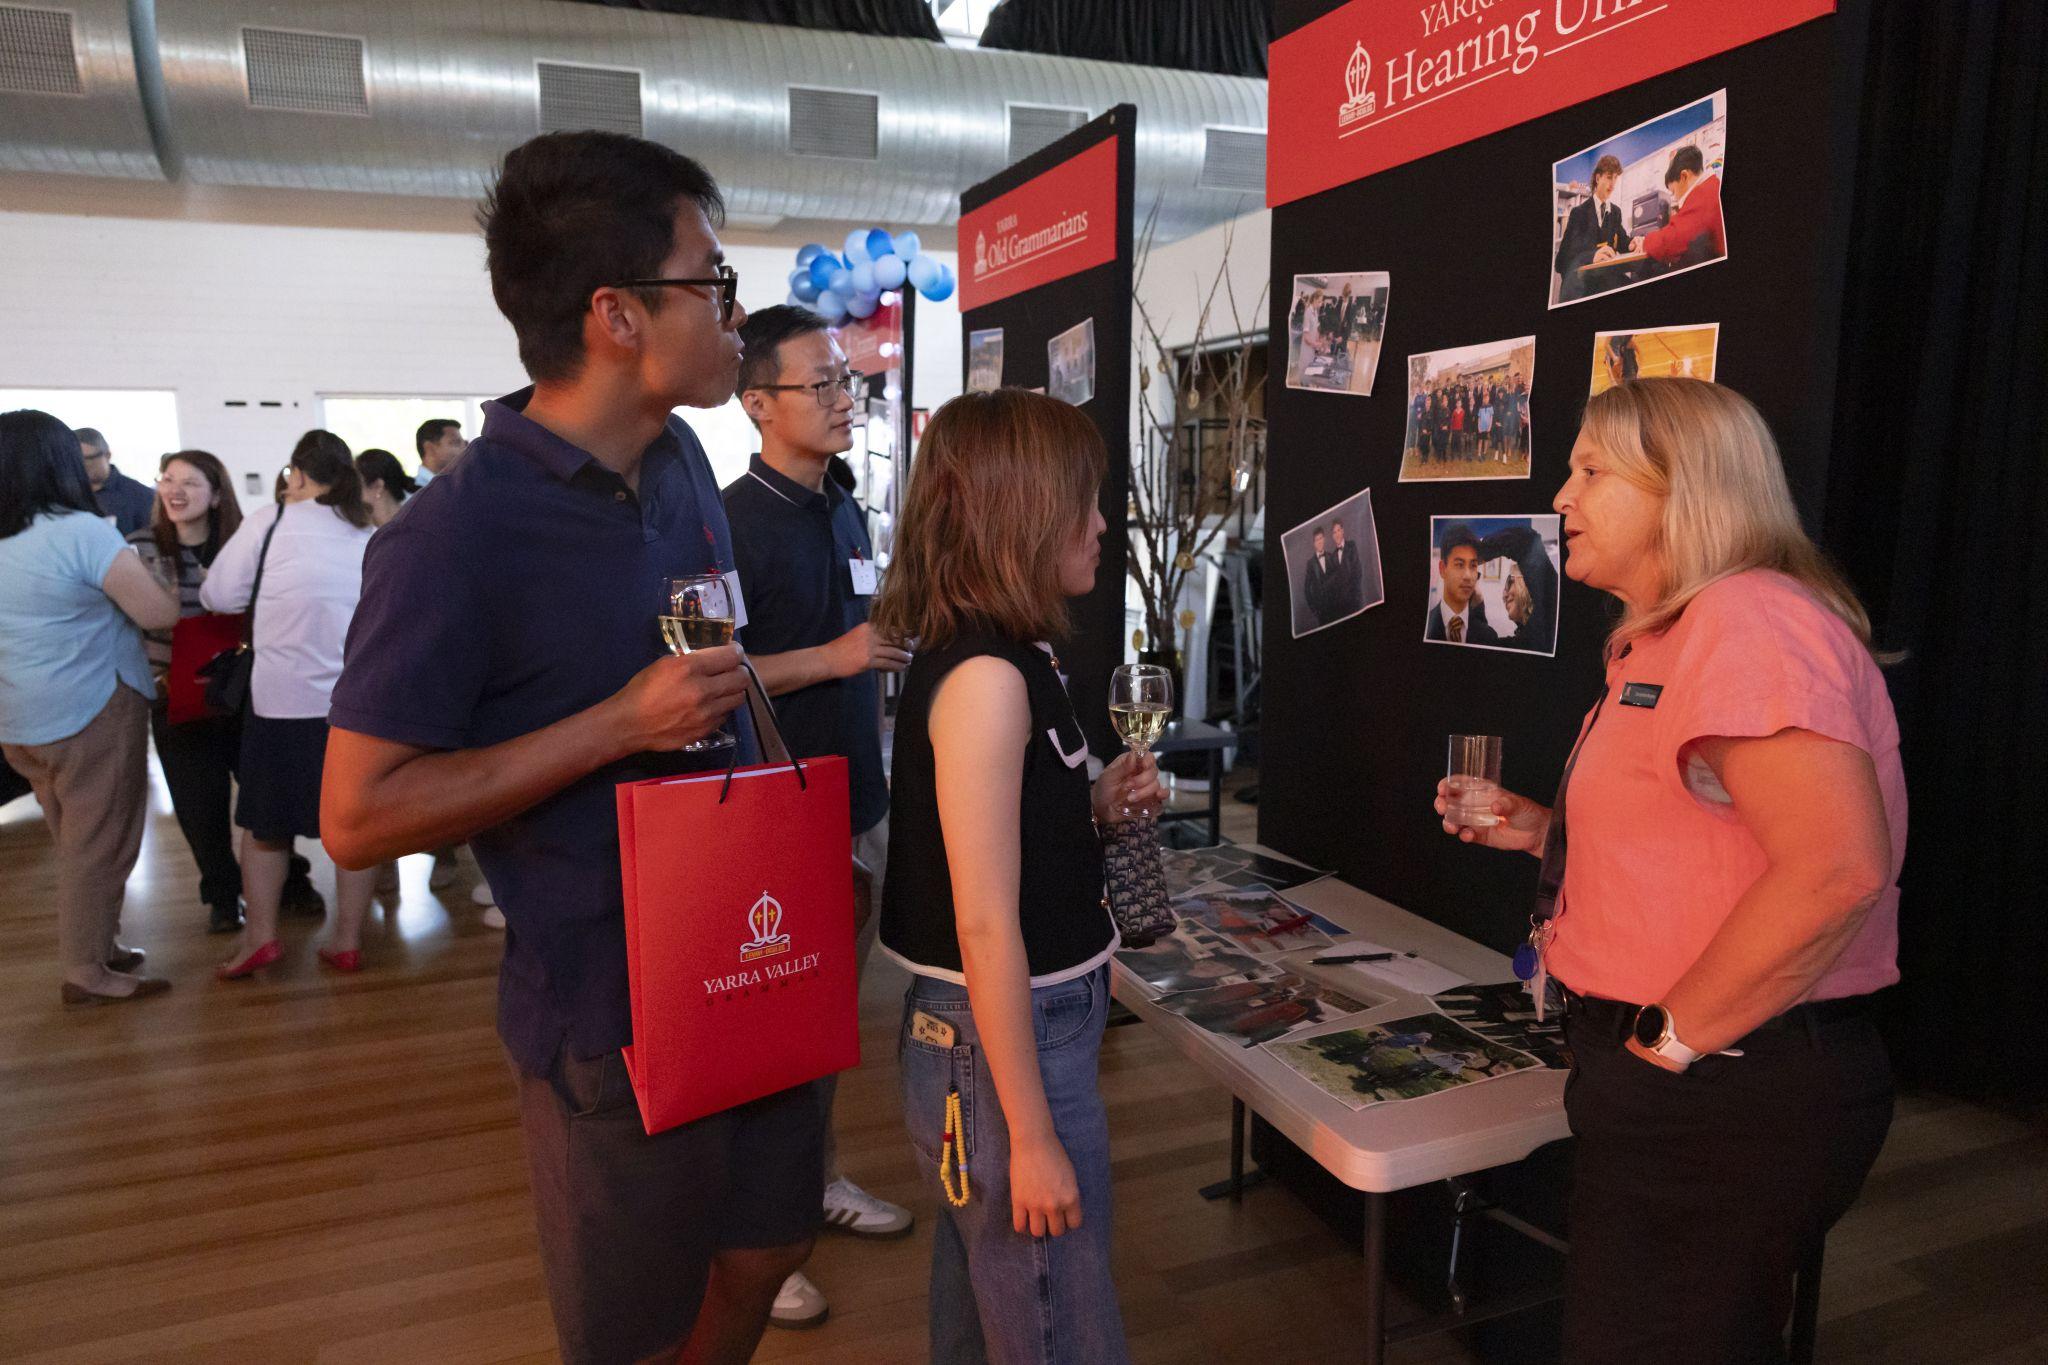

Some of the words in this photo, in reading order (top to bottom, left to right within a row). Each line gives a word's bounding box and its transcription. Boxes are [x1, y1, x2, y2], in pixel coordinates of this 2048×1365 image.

[1384, 8, 1541, 109] Hearing
[988, 236, 1008, 269] Old
[1008, 210, 1089, 260] Grammarians
[703, 969, 761, 994] YARRA
[764, 952, 821, 980] VALLEY
